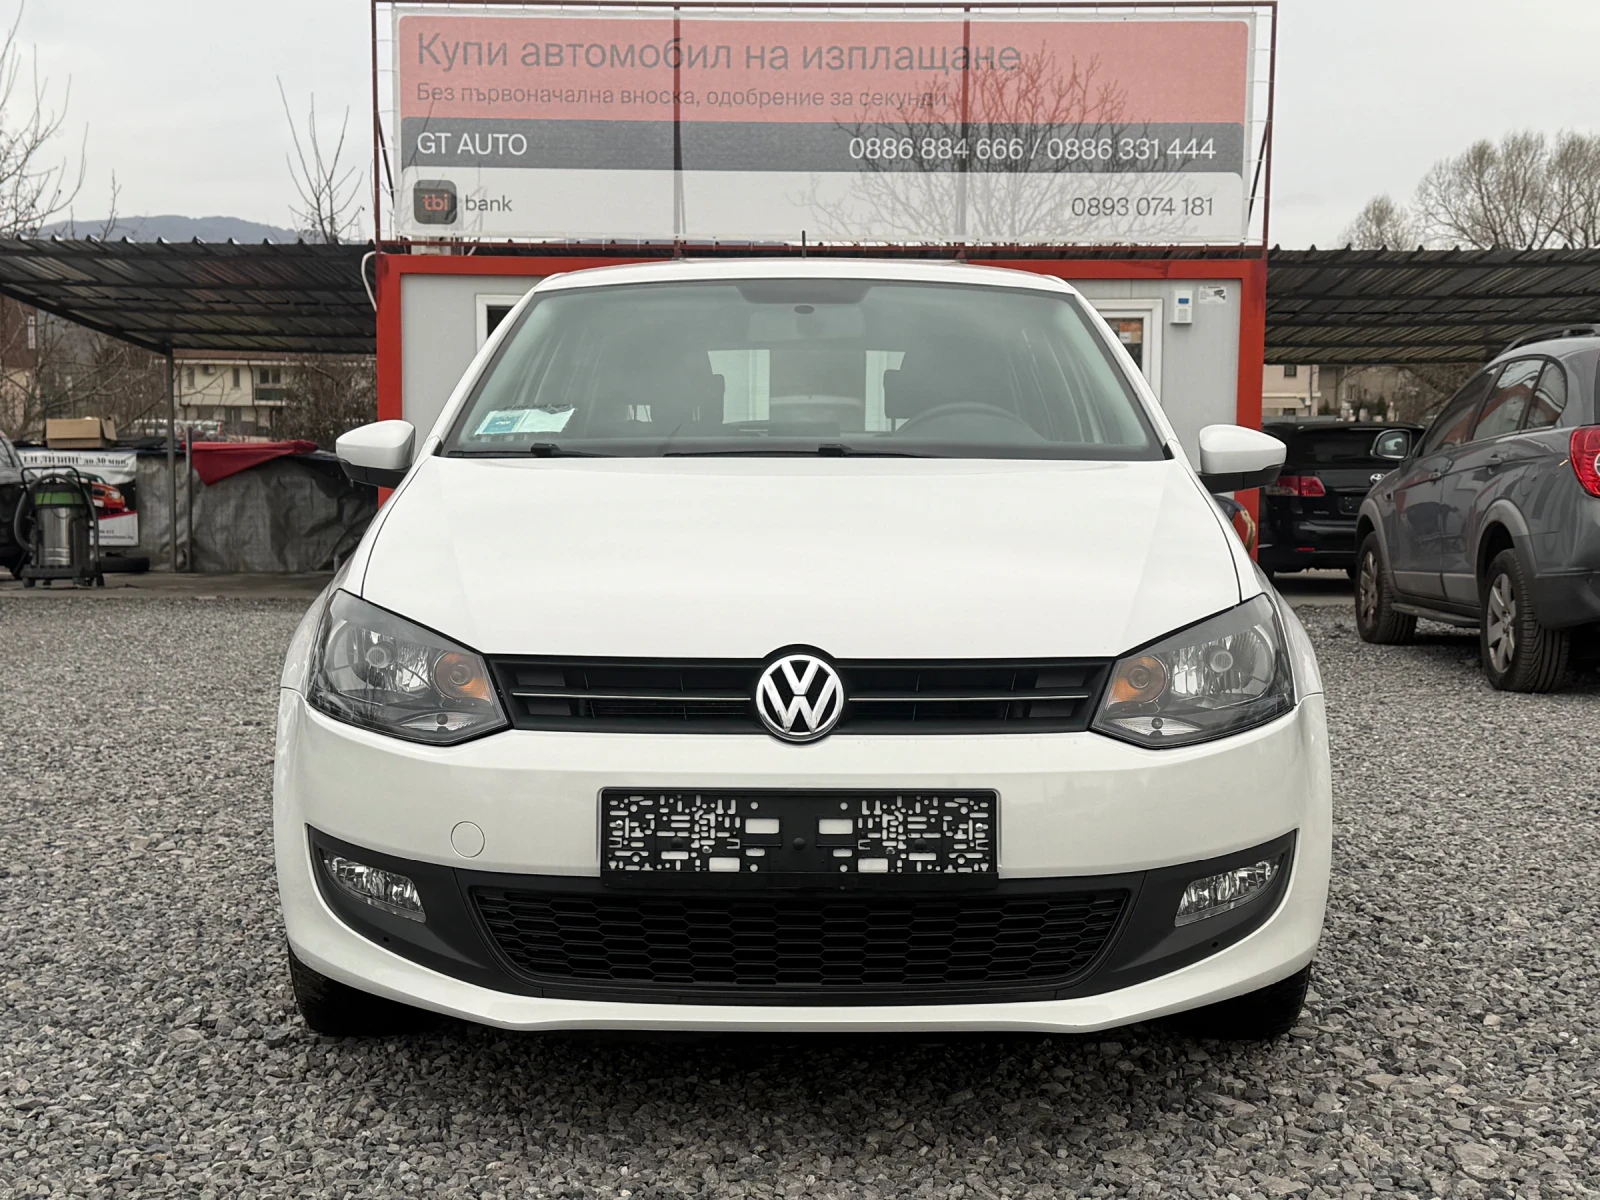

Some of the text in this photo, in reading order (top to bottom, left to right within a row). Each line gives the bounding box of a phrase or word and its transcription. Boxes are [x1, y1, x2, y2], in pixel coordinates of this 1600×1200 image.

[417, 32, 1021, 76] Купи автомобил на изплащане
[417, 82, 948, 110] Без първоначална вноска, одобрение за секунди
[416, 131, 528, 156] GT AUTO
[850, 137, 1217, 160] 0886 884 666 / 0886 331 444
[423, 193, 513, 212] tbi bank
[1071, 197, 1214, 217] 0893 074 181
[758, 655, 842, 738] VW
